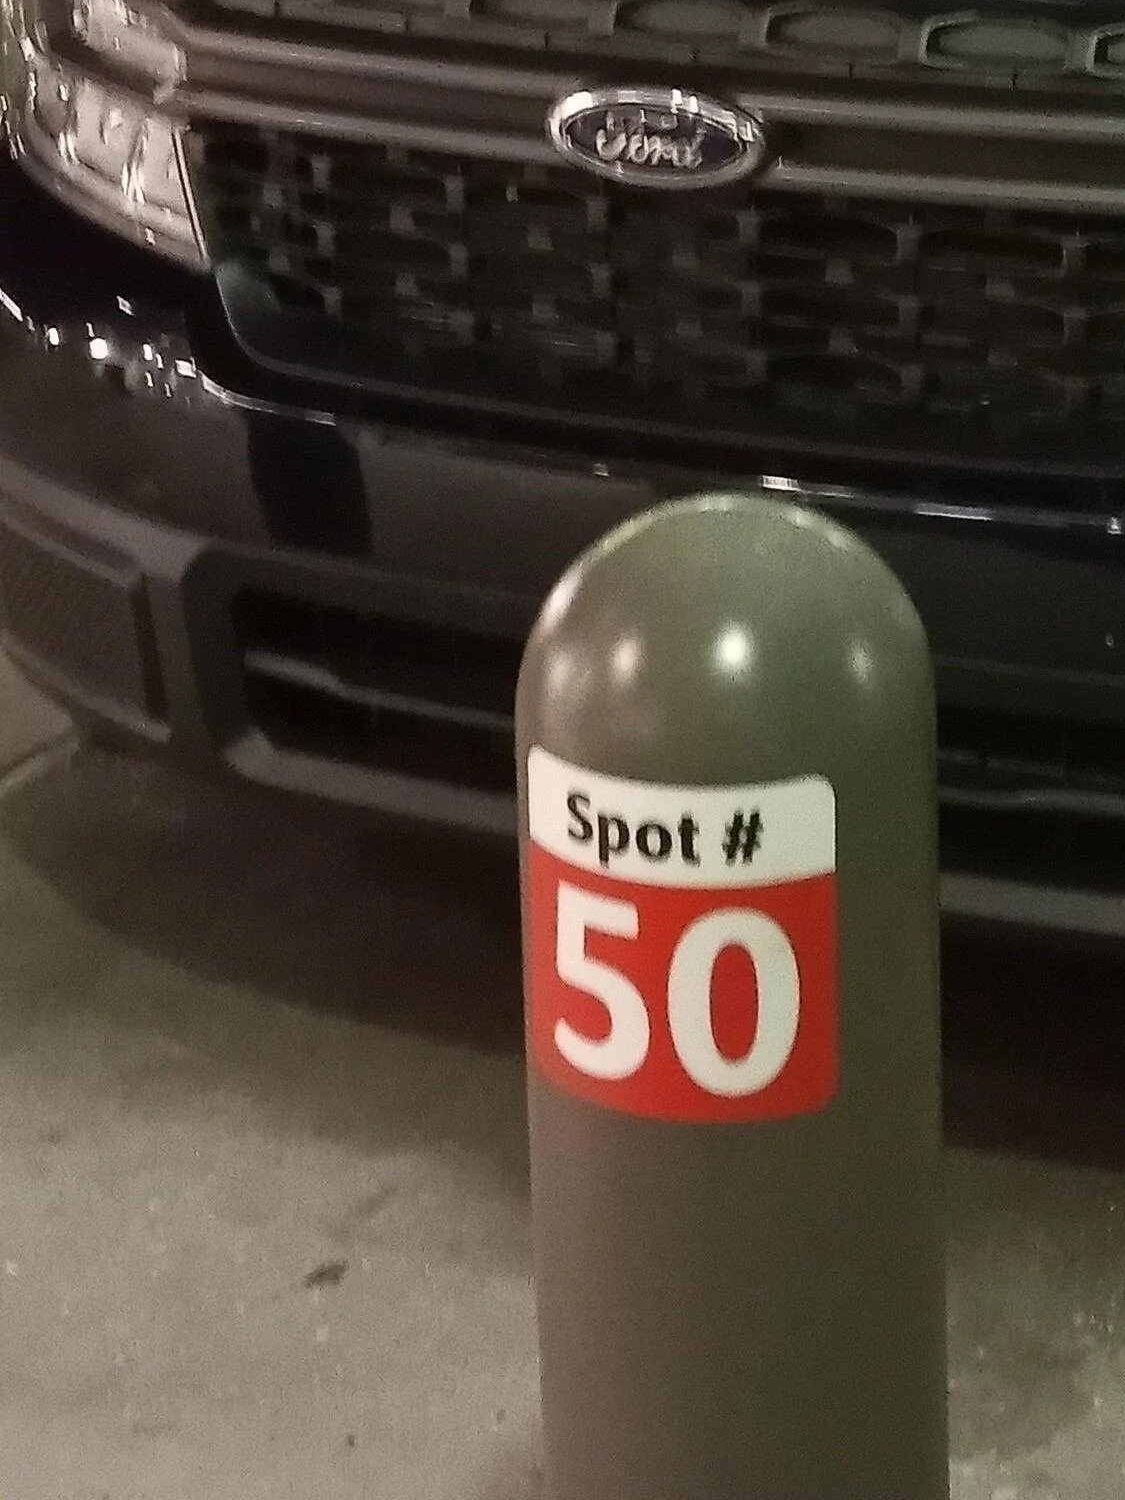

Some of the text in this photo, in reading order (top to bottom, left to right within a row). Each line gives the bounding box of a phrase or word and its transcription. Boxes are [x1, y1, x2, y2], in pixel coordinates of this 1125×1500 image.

[595, 115, 707, 169] Ford
[565, 792, 764, 868] Spot #
[553, 880, 801, 1098] 50
